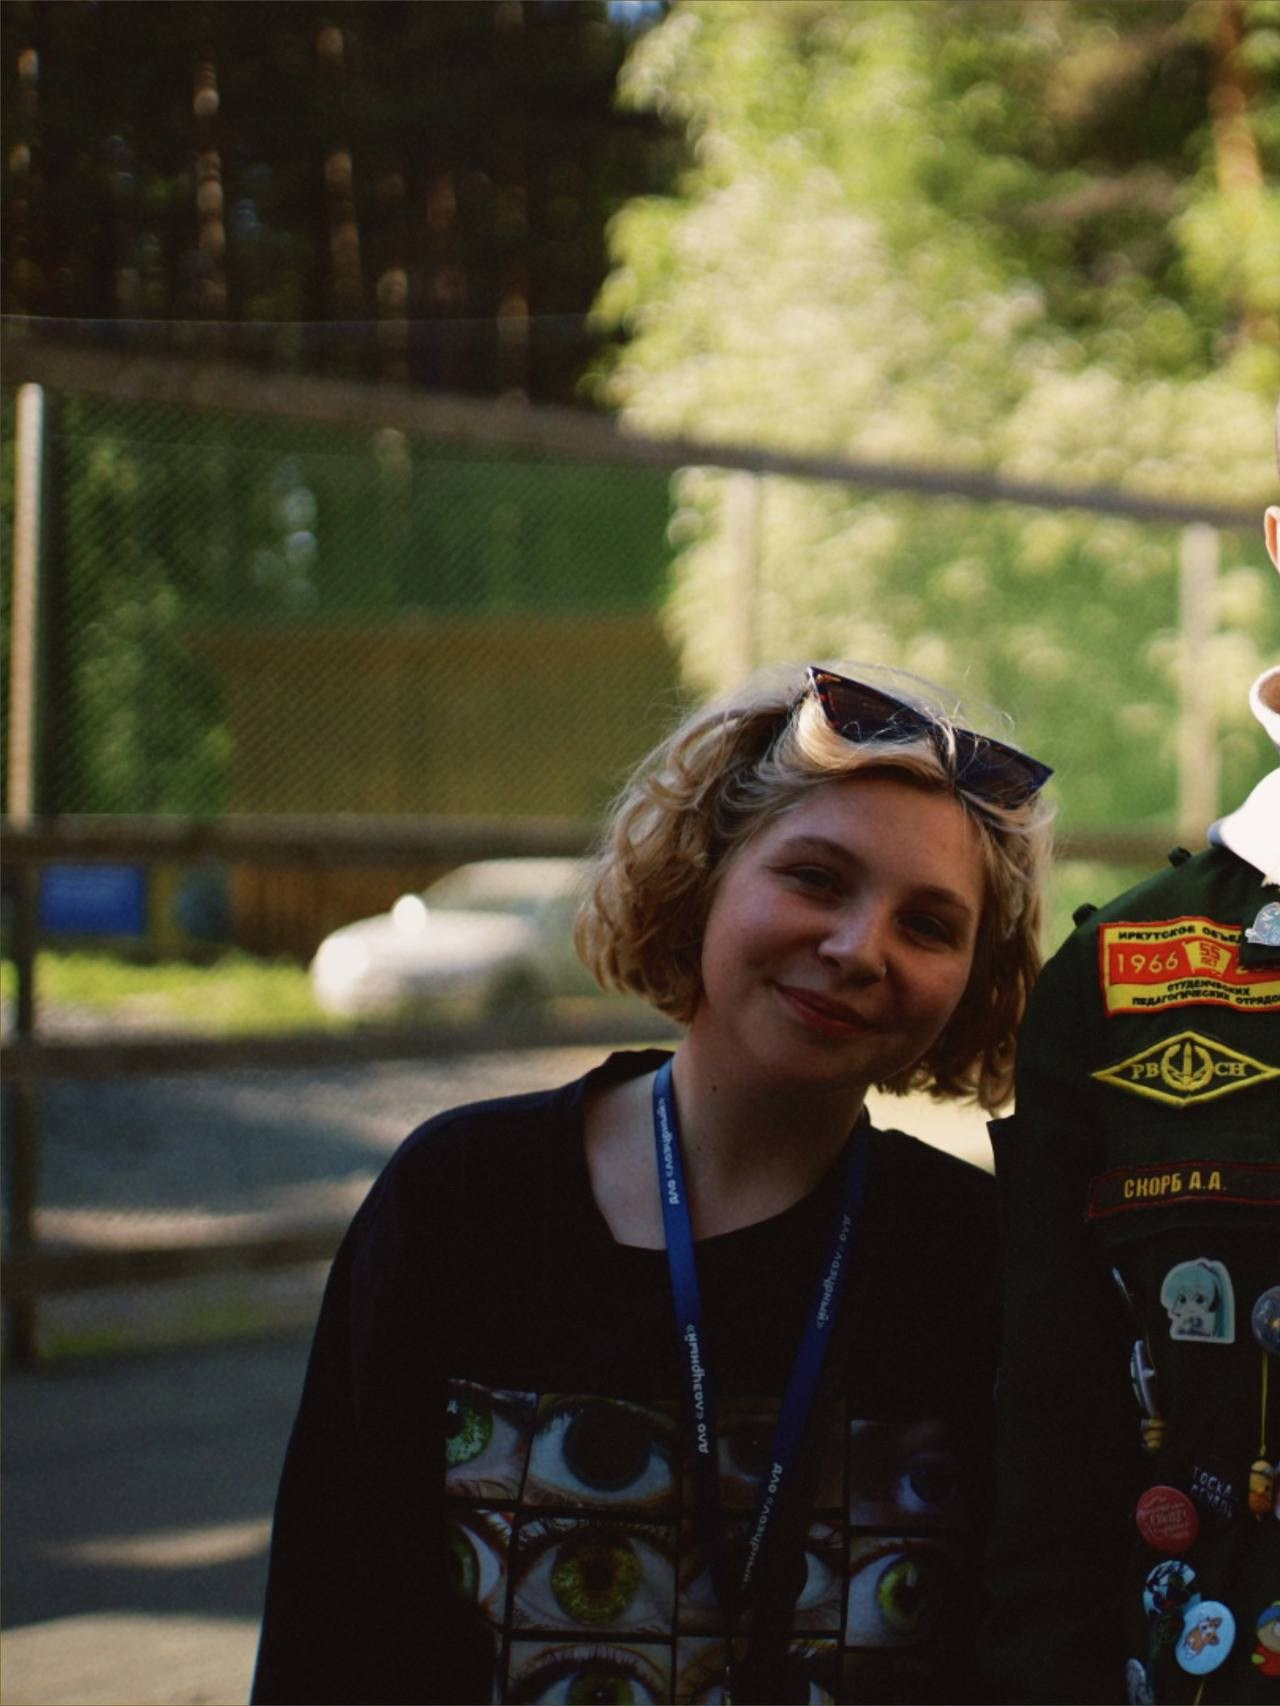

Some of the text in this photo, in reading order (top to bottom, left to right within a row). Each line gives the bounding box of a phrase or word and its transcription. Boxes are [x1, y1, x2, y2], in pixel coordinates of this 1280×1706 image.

[1118, 925, 1196, 940] ИРКУТСКОЕ
[1199, 942, 1220, 960] 55
[1117, 951, 1179, 974] 1966
[1167, 980, 1250, 996] СТУДЕНЧЕСКИХ
[1132, 989, 1230, 1006] ПЕДАГОГИЧЕСКИХ
[1123, 1173, 1182, 1199] СКОРБ
